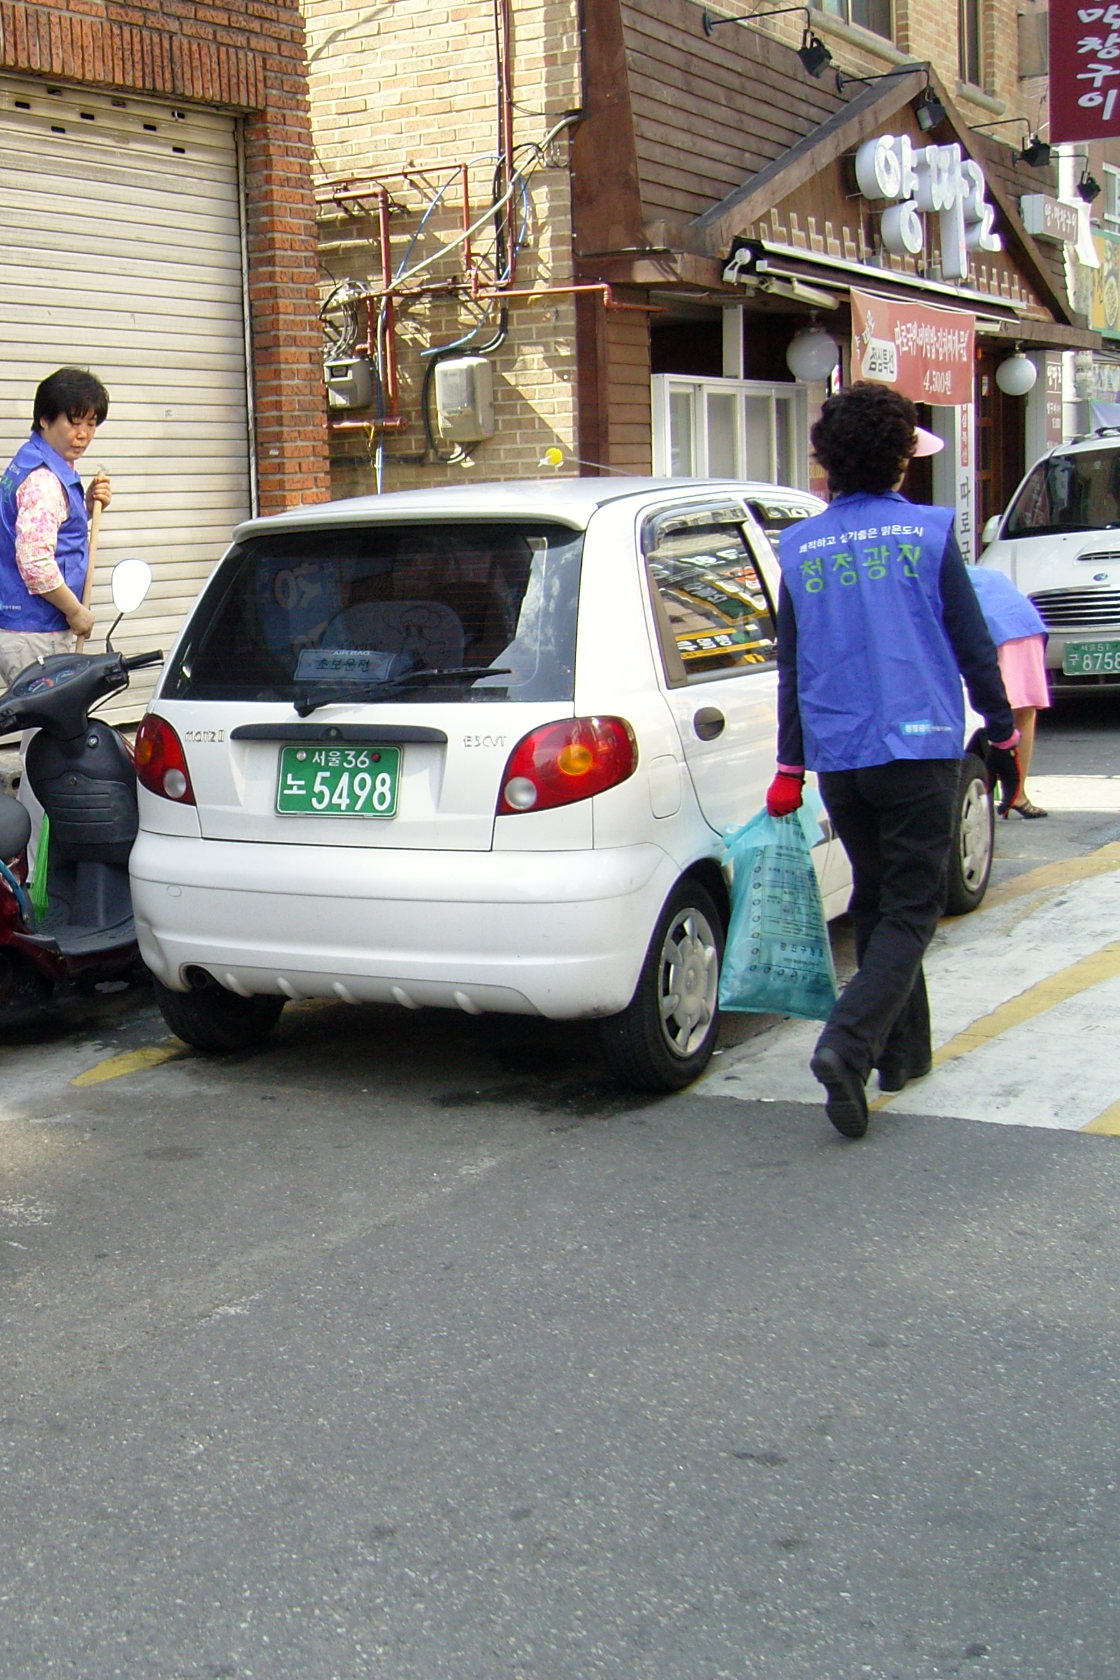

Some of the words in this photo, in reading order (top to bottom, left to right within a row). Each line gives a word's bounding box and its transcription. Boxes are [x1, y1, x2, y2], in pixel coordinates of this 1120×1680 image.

[880, 523, 925, 538] 맑은도시
[799, 543, 922, 594] 청정광진
[315, 657, 370, 672] 초보운전
[283, 773, 307, 796] 노
[311, 771, 392, 812] 5498
